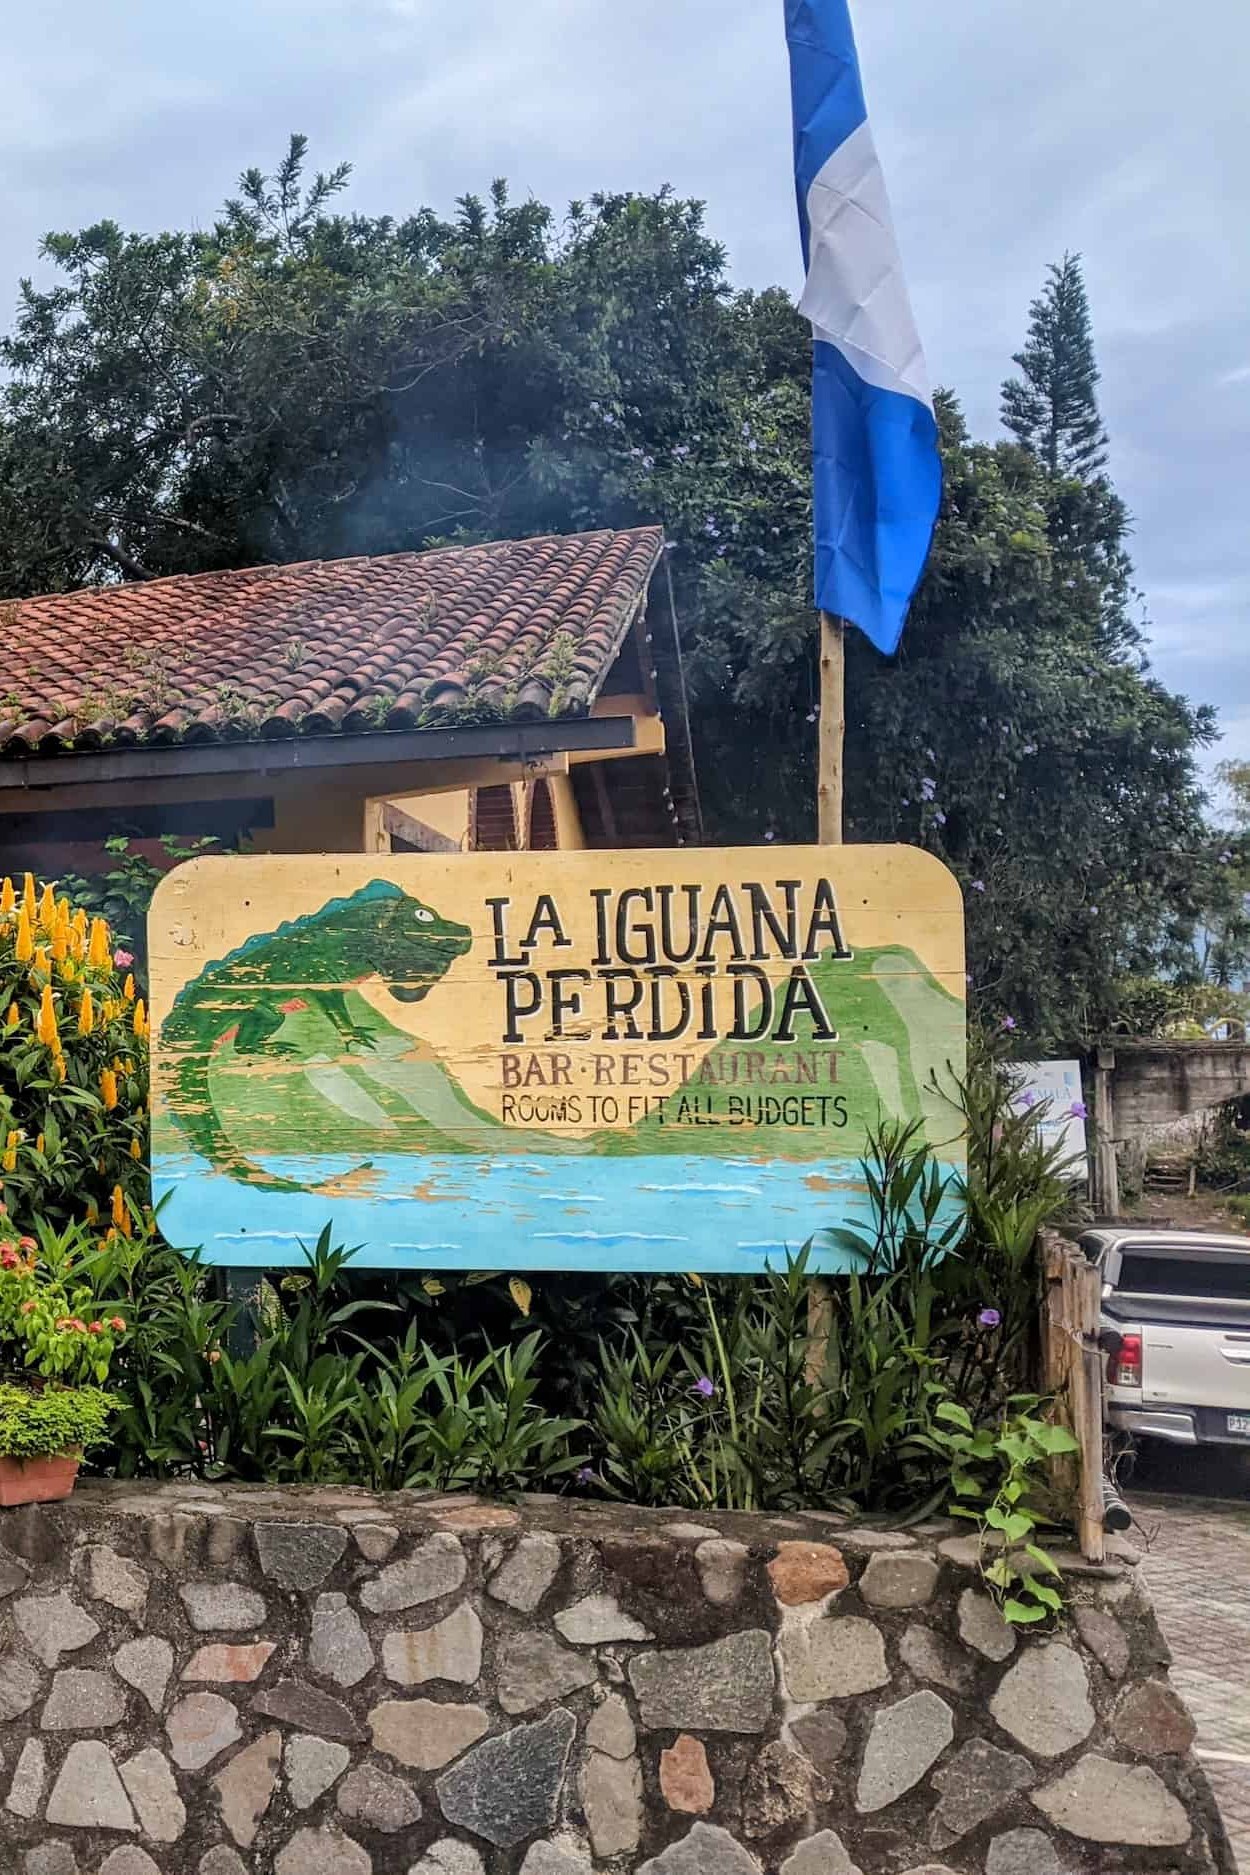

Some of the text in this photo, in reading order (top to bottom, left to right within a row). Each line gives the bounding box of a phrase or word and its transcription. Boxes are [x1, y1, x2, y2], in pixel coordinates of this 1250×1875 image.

[486, 879, 852, 966] LA IGUANA
[497, 965, 839, 1043] PERDIDA
[502, 1095, 848, 1128] ROOMS TO FIT ALL BUDGETS
